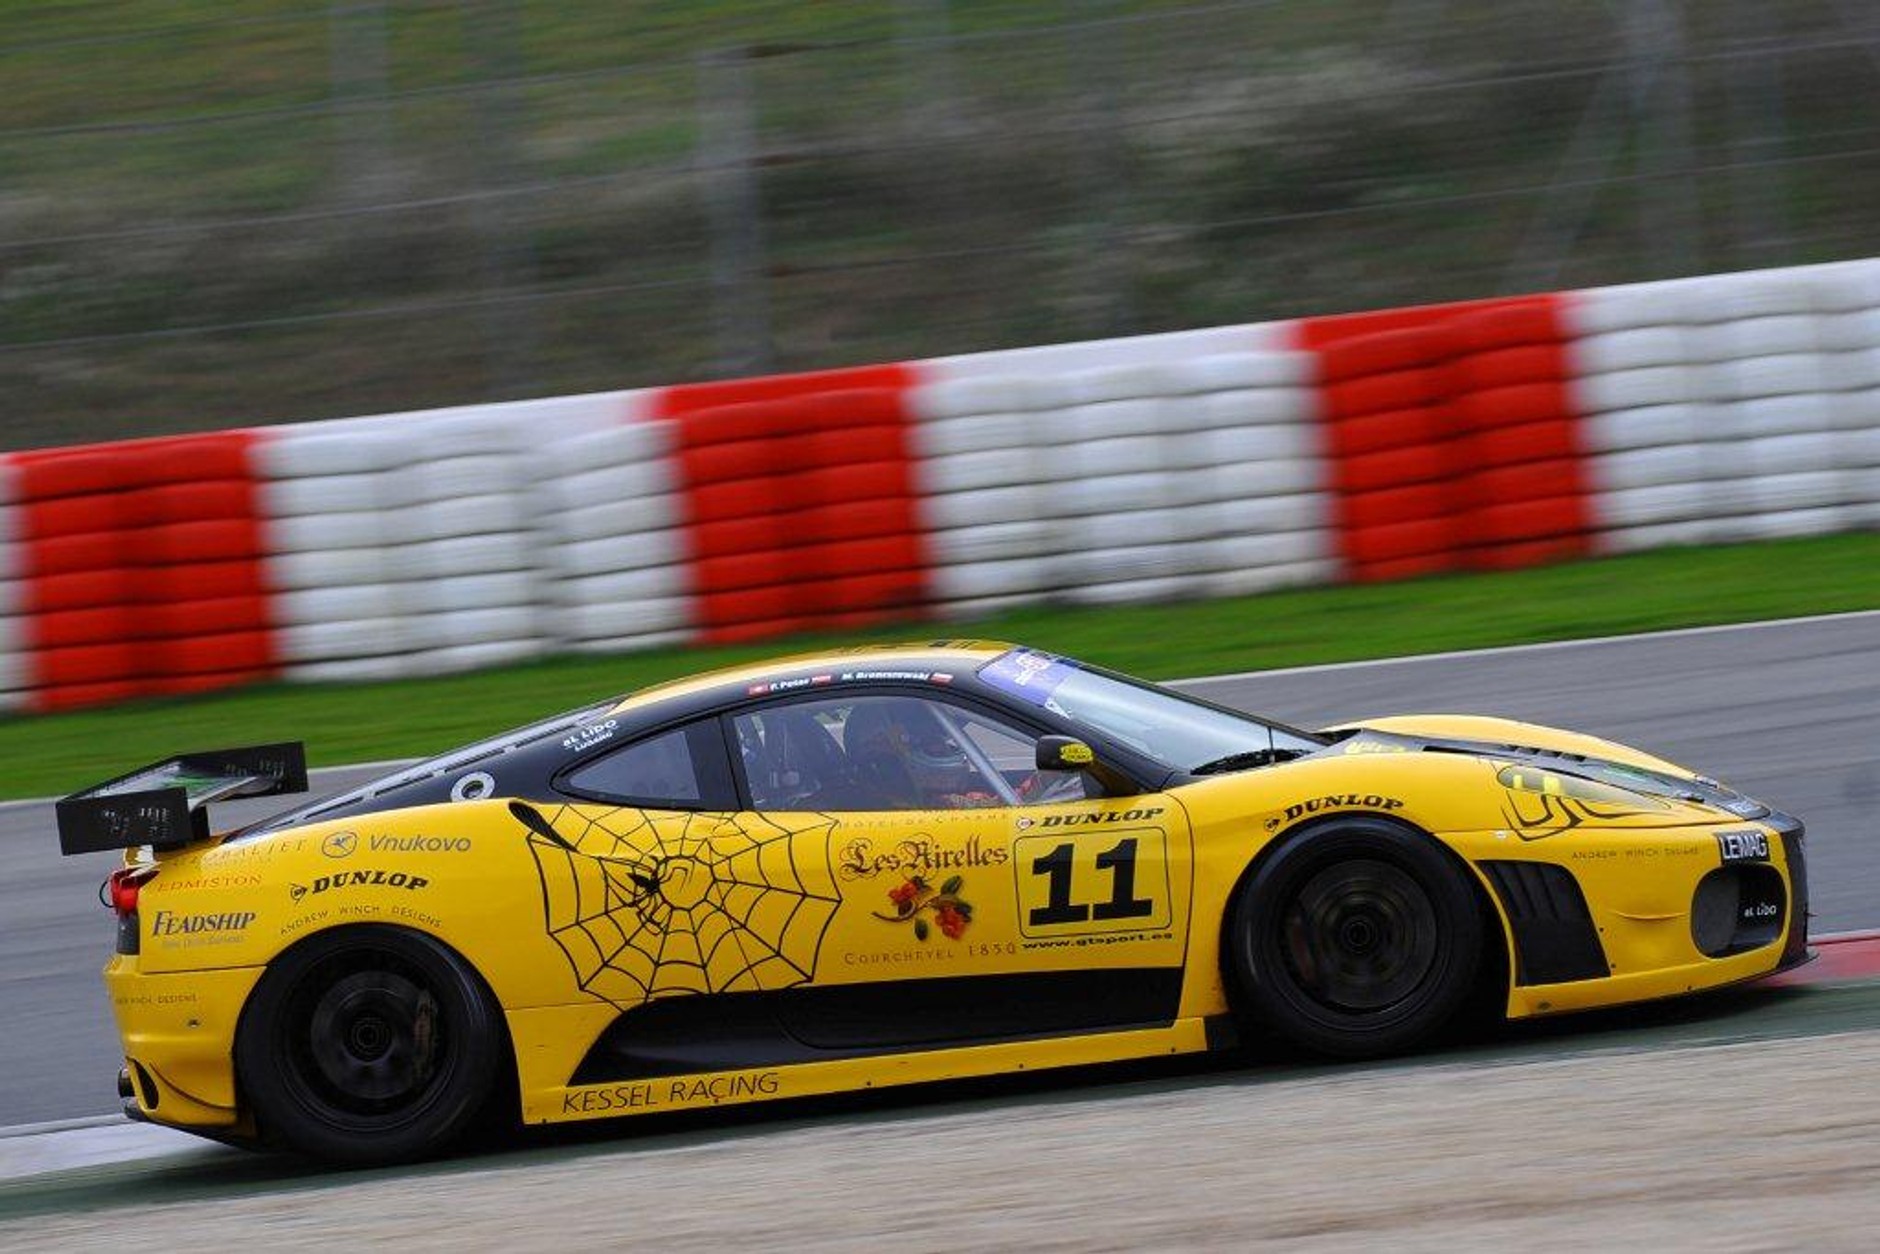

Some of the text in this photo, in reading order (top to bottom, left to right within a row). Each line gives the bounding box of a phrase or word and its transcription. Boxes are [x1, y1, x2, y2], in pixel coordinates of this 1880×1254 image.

[1040, 807, 1165, 828] DUNLOP
[1284, 794, 1404, 822] DUNLOP
[370, 833, 472, 852] Vnukovo
[1720, 833, 1768, 860] LEMAG
[840, 832, 1008, 882] Les Airelles
[157, 873, 263, 893] EDMISTON
[312, 869, 430, 895] DUNLOP
[1029, 838, 1154, 927] 11
[280, 904, 442, 936] ANDREW WINCH DESIGNS
[1022, 932, 1173, 950] www.gtsport.es
[843, 943, 1016, 966] COURCHEVEL 1850
[562, 1084, 658, 1114] KESSEL
